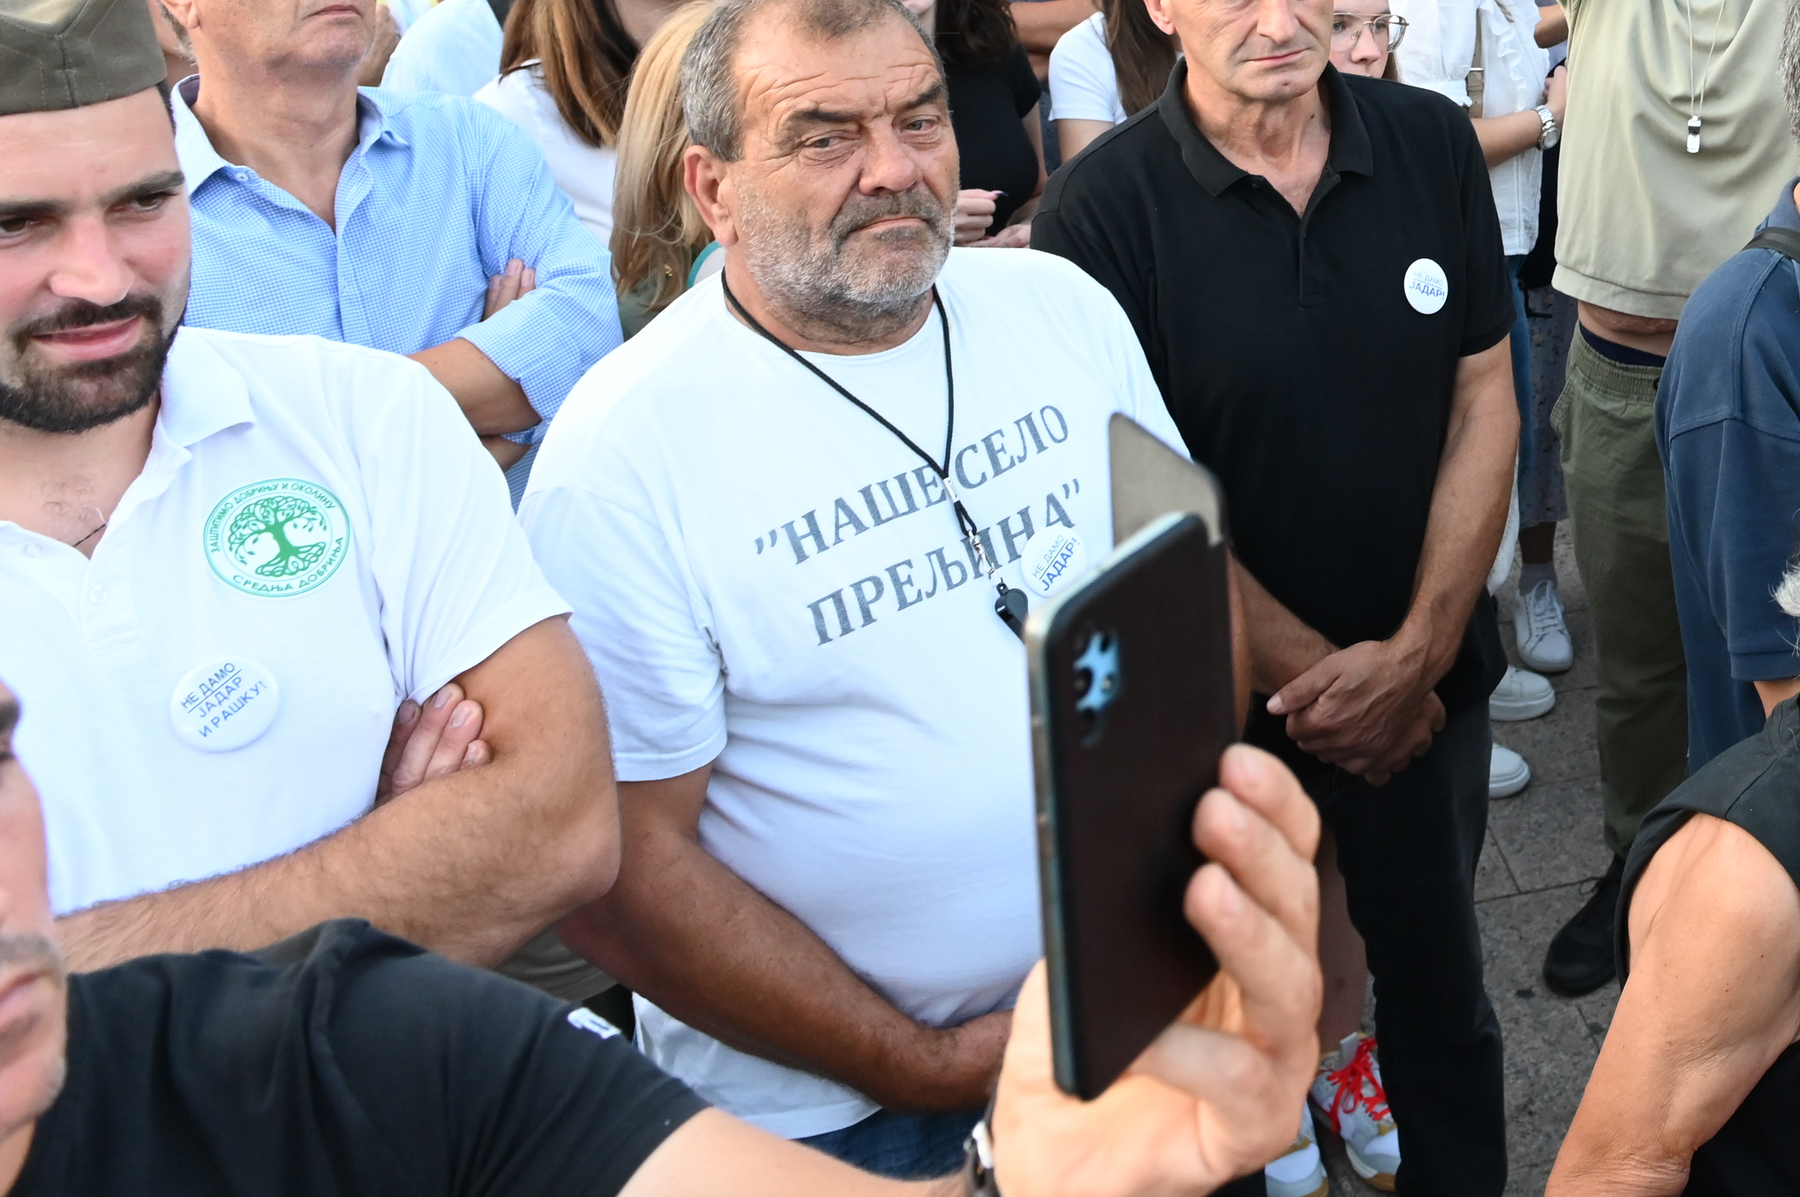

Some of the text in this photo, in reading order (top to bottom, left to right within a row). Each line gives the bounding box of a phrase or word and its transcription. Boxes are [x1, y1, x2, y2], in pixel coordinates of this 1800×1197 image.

[954, 405, 1069, 490] СЕЛО
[291, 482, 336, 510] ОКОЛИНУ
[232, 536, 344, 592] СРЕДЊА ДОБРИЊА
[1031, 534, 1065, 578] НЕ ДАМО
[1042, 537, 1080, 592] ЈАДАР!
[180, 662, 235, 709] НЕ ДАМО
[198, 676, 242, 718] ЈАДАР
[198, 680, 267, 738] И РАШКУ!
